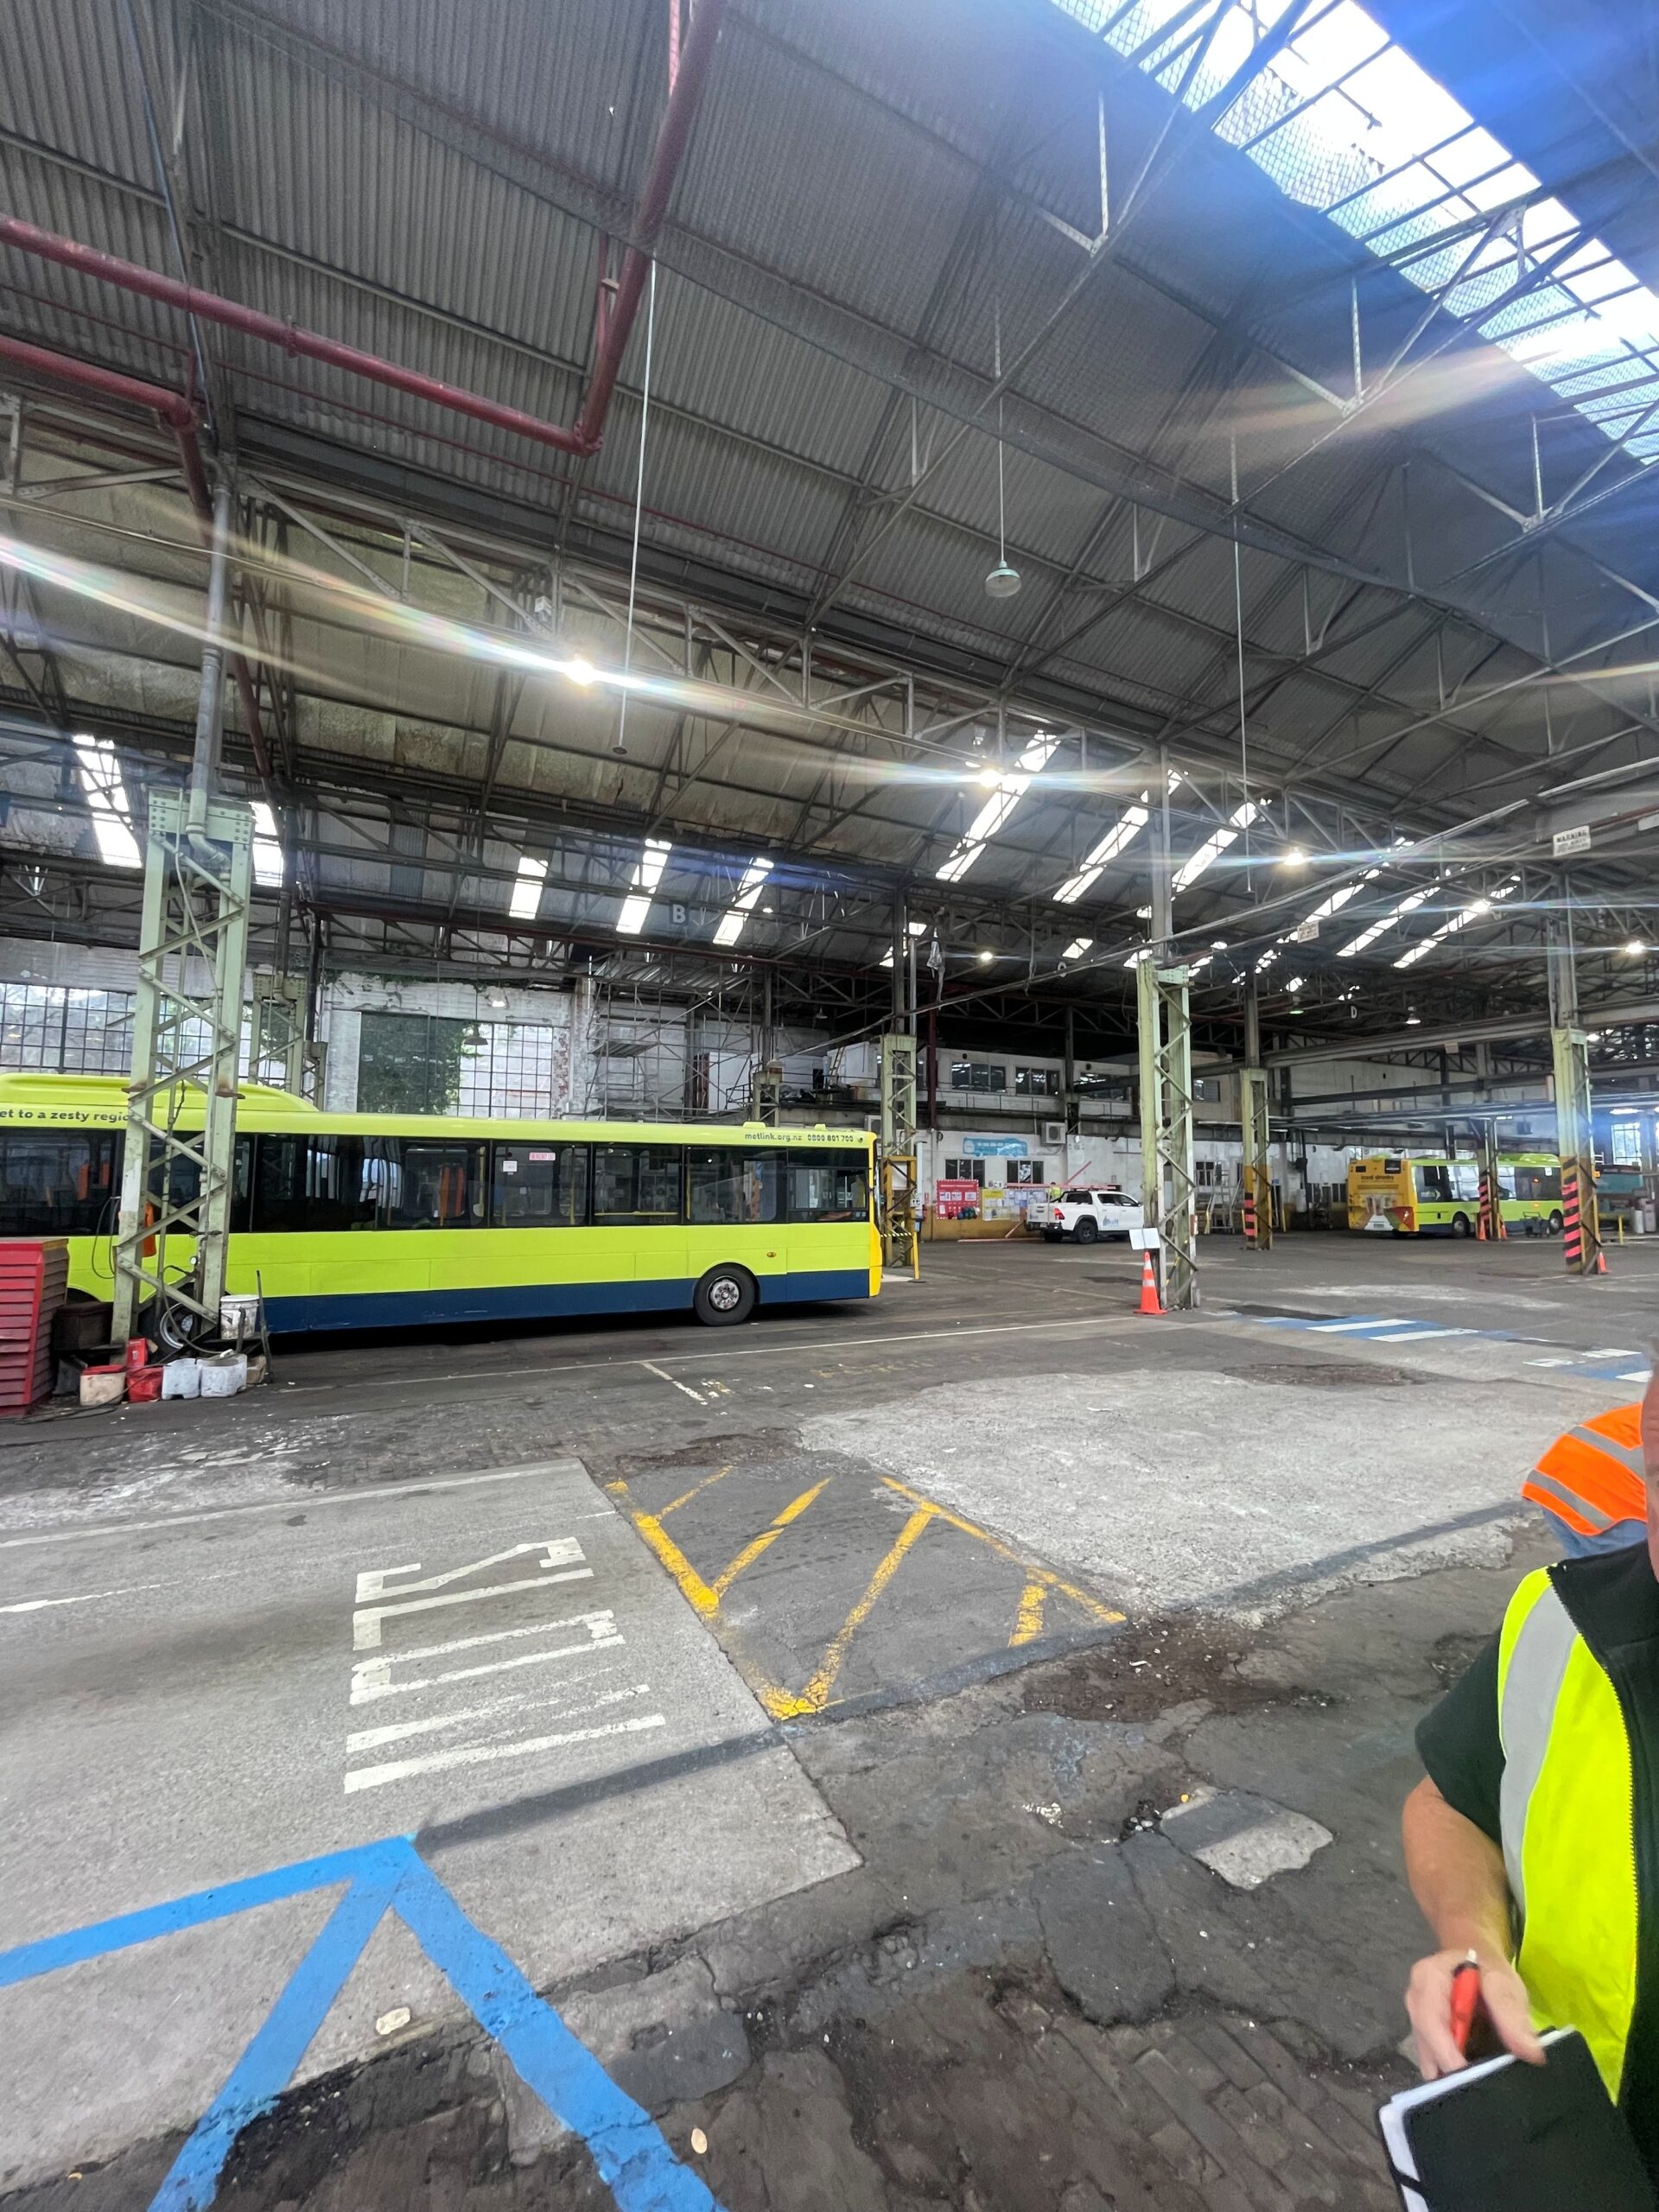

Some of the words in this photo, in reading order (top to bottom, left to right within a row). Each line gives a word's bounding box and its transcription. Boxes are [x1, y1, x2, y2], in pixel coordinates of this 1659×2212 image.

[1556, 830, 1587, 842] WARNING
[672, 904, 685, 923] B
[1351, 1005, 1357, 1019] D
[19, 1109, 33, 1118] to
[50, 1111, 89, 1122] zesty
[93, 1112, 130, 1123] regio
